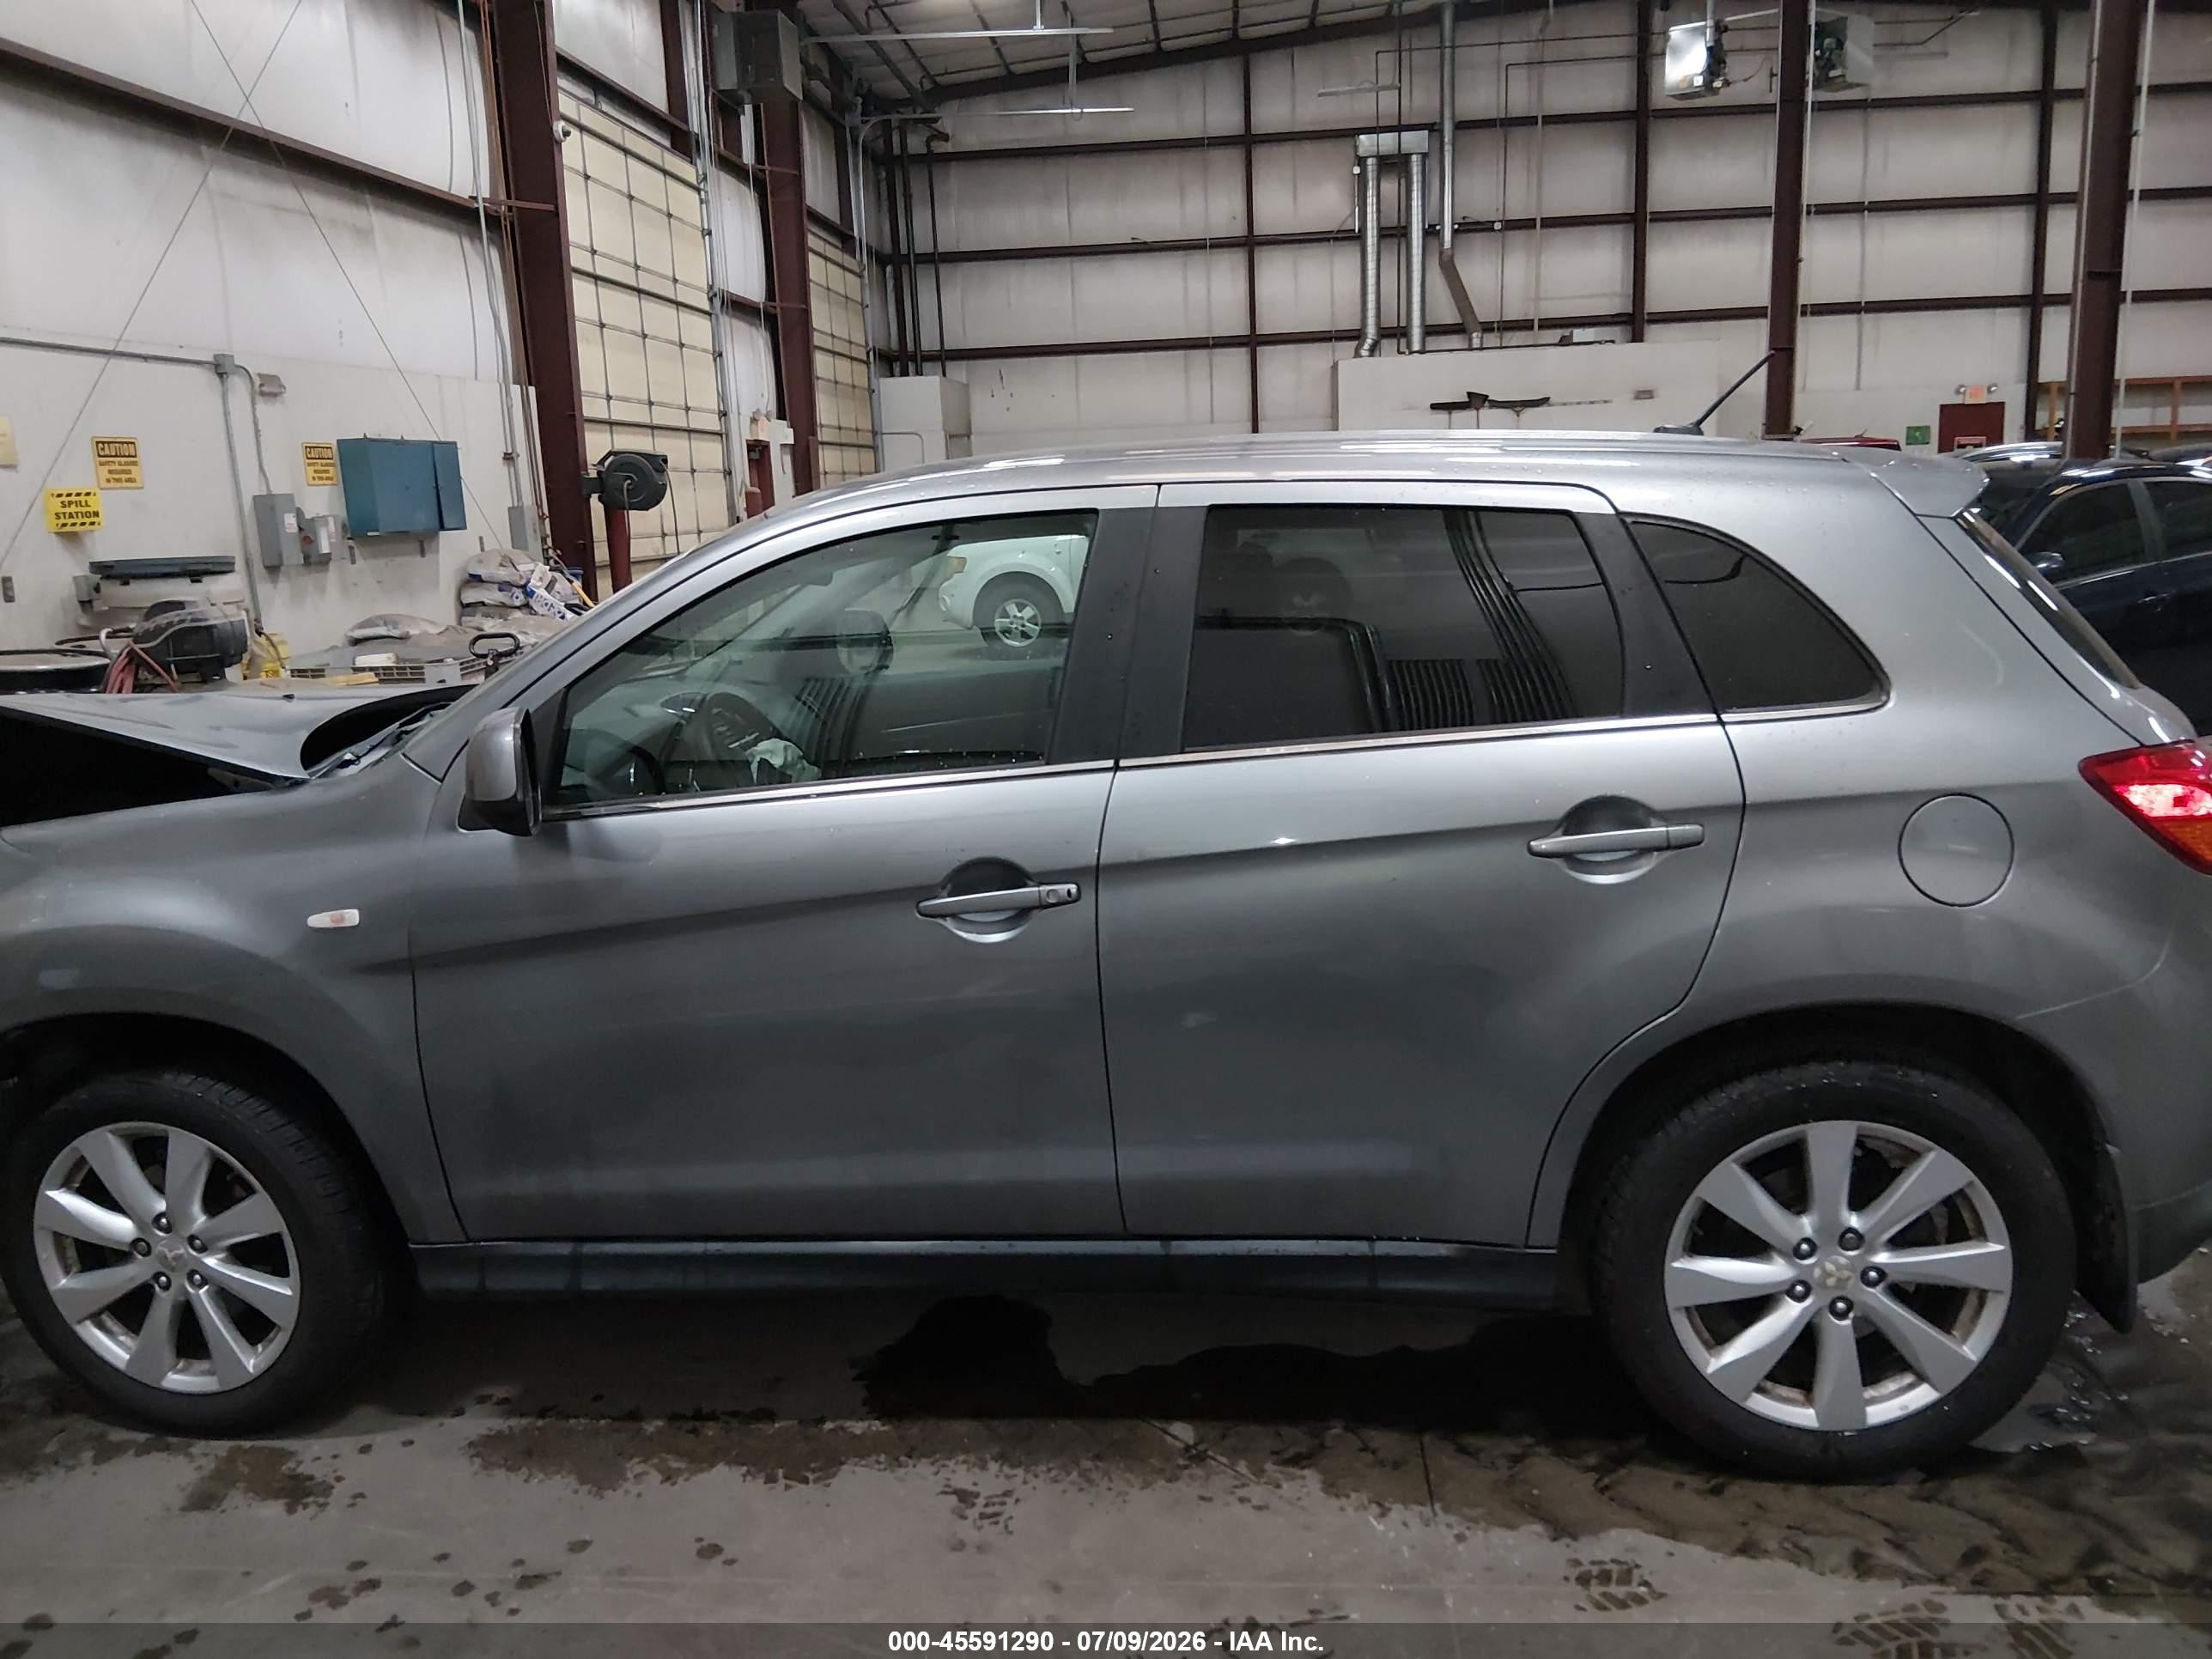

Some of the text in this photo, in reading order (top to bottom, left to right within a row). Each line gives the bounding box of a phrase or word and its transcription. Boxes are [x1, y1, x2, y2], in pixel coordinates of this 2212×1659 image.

[98, 442, 136, 456] CAUTION
[306, 447, 333, 459] CAUTION
[60, 500, 91, 508] SPILL
[54, 511, 100, 520] STATION
